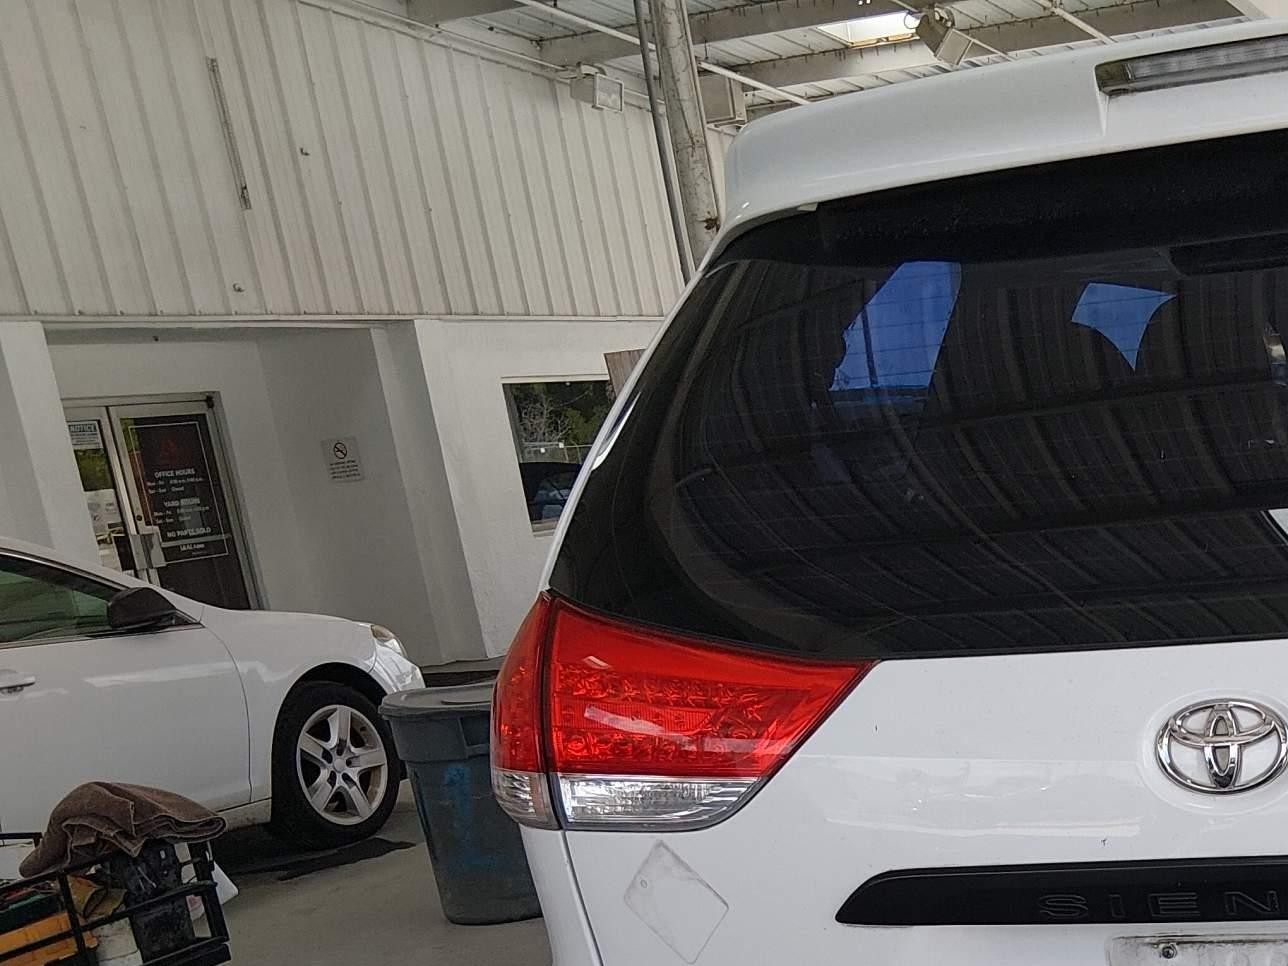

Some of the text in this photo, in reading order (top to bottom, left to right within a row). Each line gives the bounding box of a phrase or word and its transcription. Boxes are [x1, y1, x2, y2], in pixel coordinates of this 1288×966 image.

[70, 424, 95, 432] NOTICE
[154, 468, 196, 479] OFFICE HOURS
